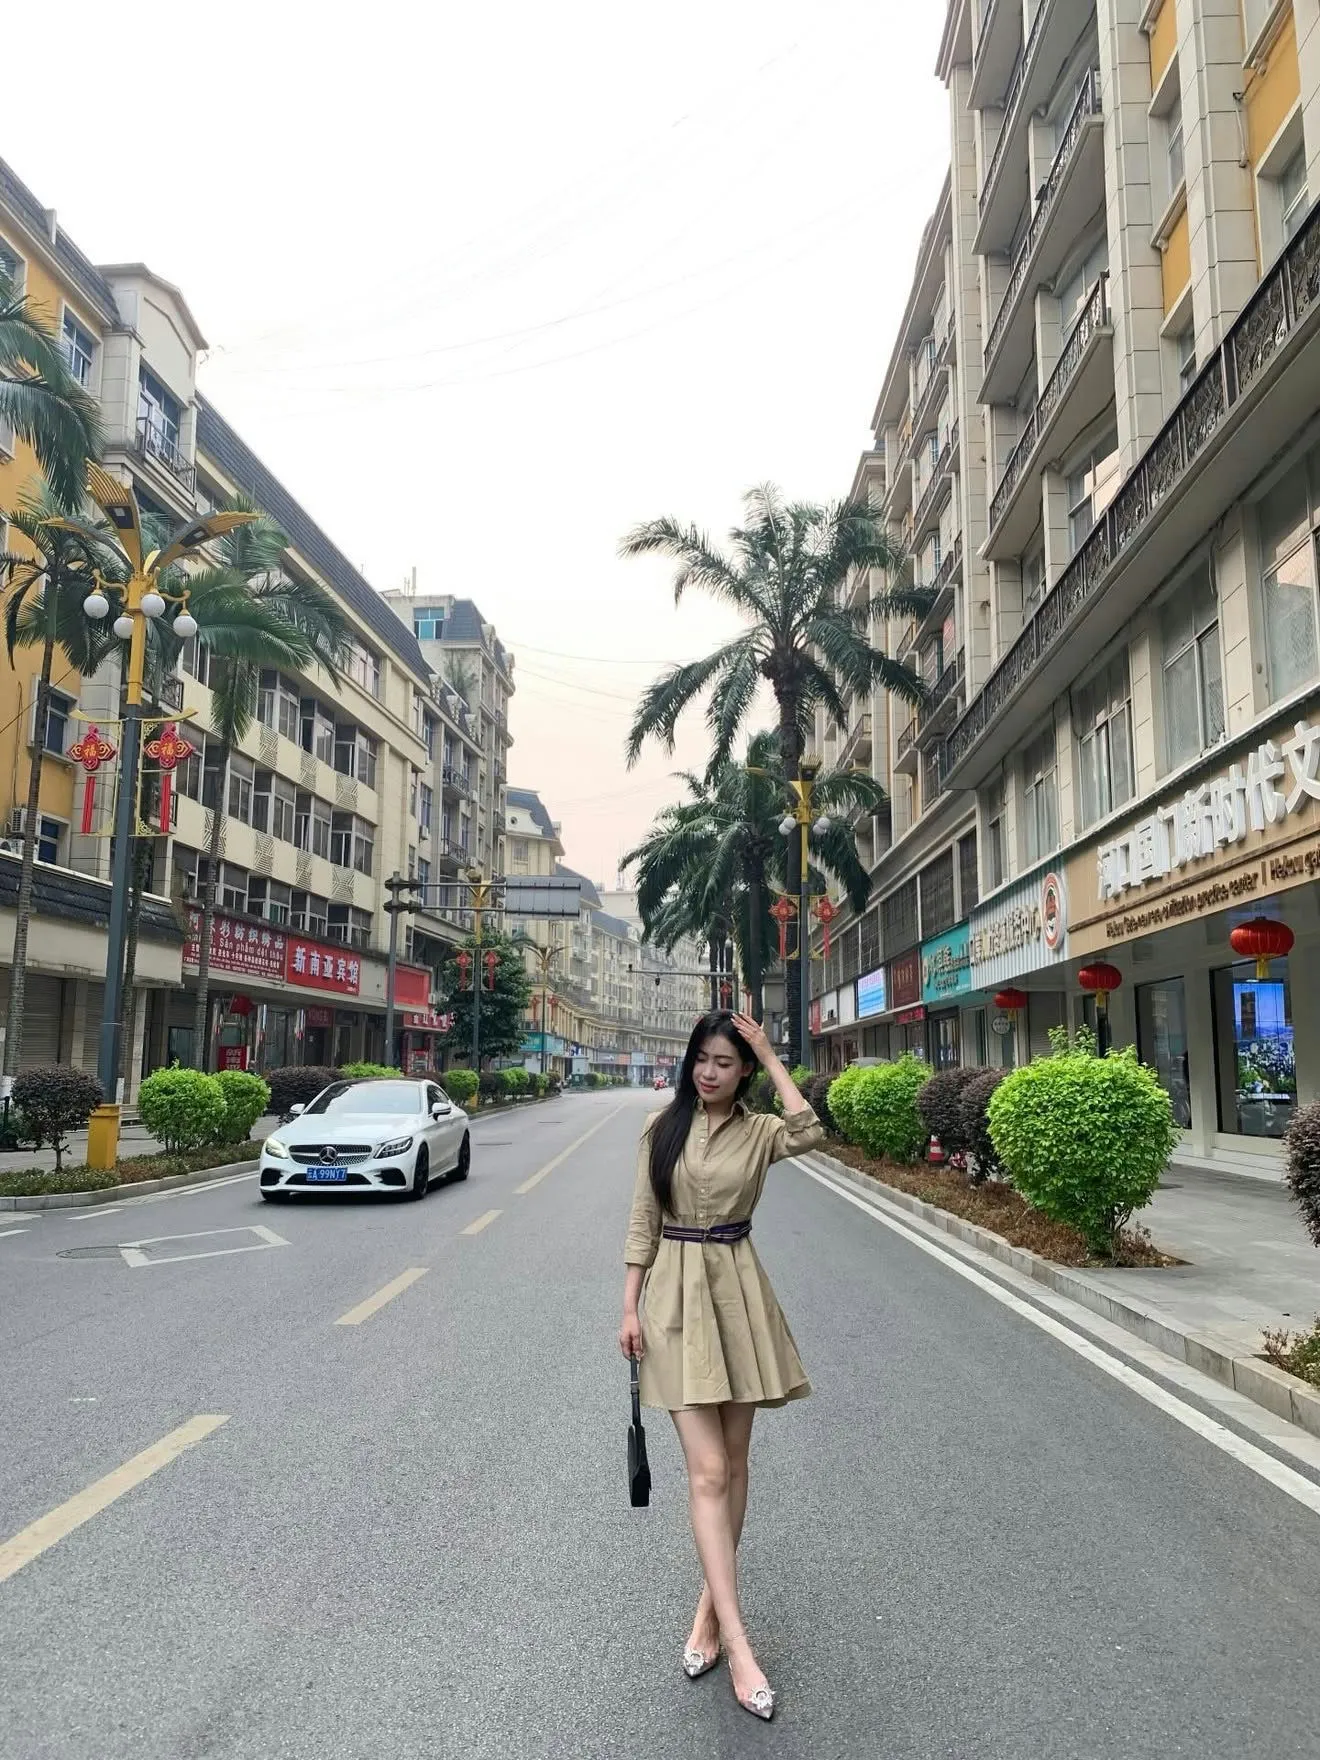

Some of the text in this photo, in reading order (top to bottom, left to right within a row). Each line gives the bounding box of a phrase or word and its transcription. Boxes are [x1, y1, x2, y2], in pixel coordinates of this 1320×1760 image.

[84, 743, 97, 758] 福
[161, 742, 174, 756] 福
[290, 945, 359, 985] 新南亚宾馆
